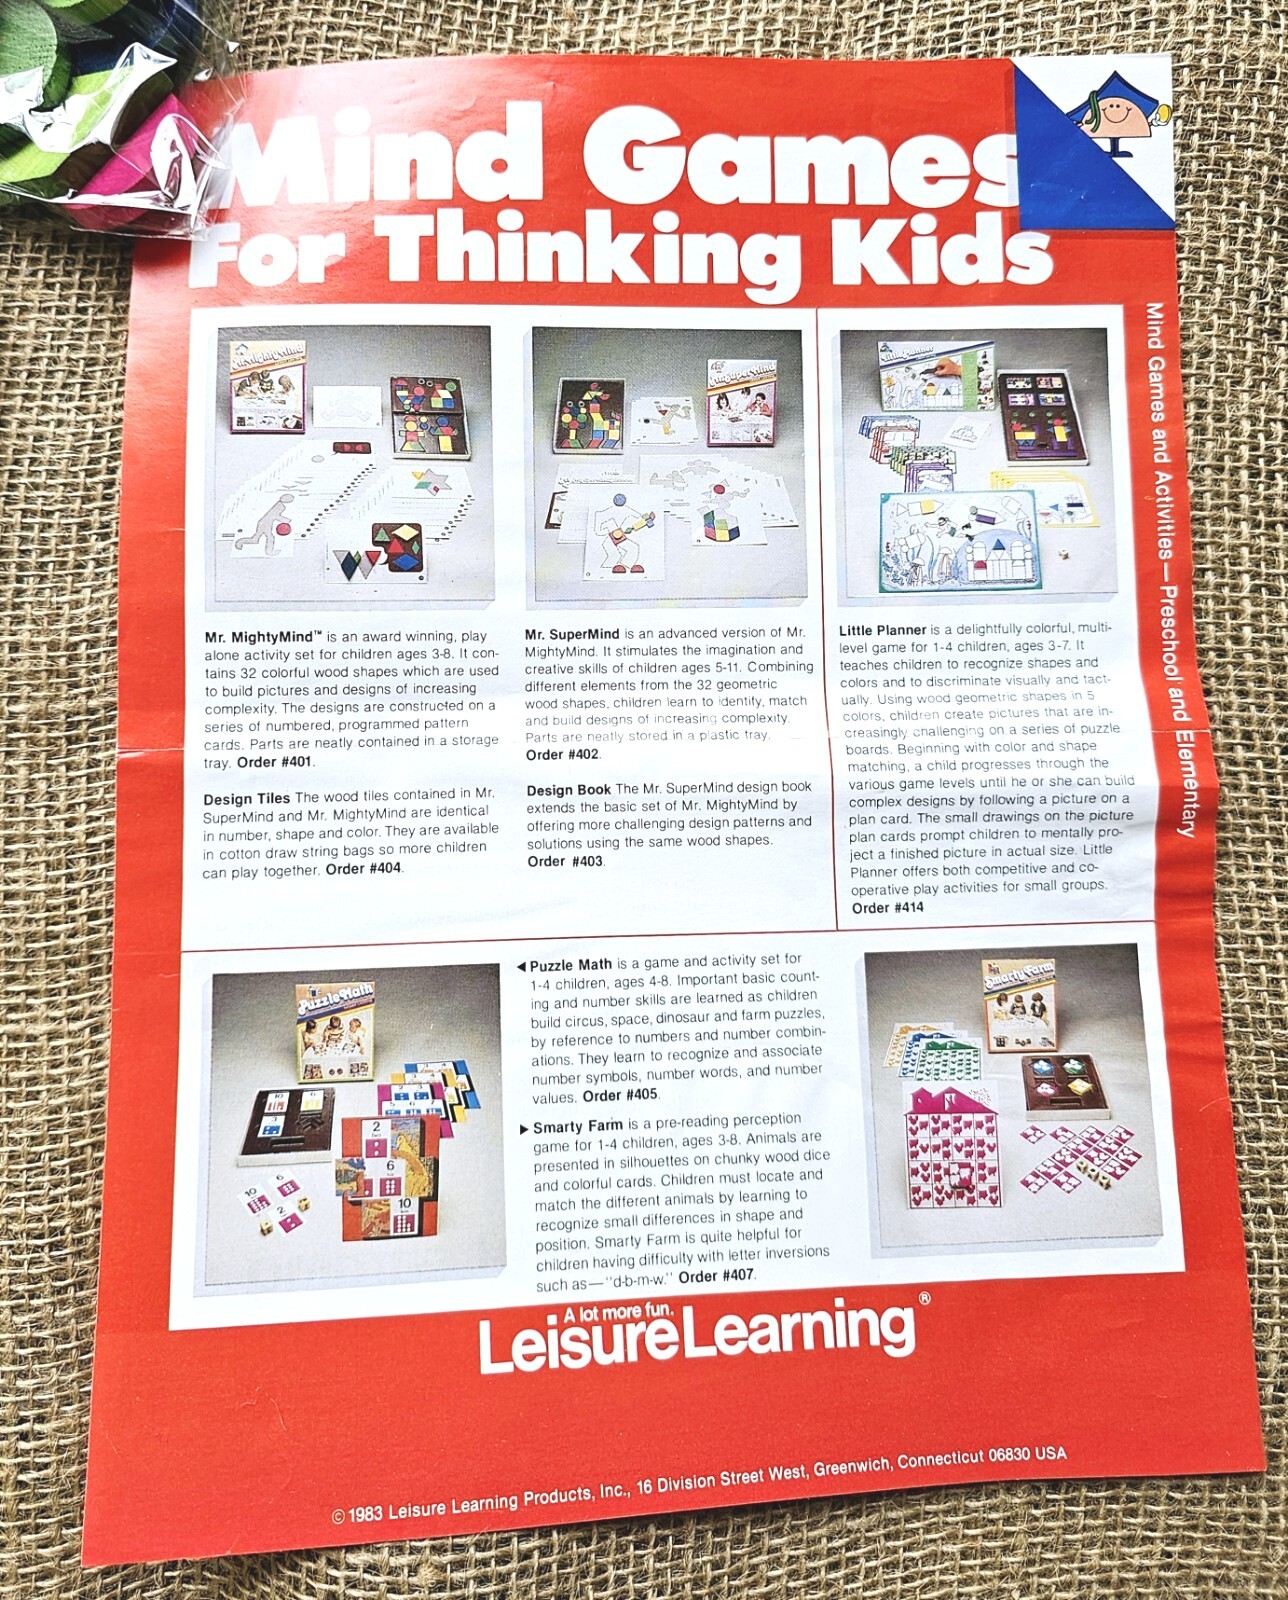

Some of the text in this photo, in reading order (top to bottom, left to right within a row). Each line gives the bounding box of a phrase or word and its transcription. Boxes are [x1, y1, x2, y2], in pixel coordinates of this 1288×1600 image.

[211, 101, 543, 209] Mind
[188, 208, 1053, 305] For Thinking Kids
[1146, 303, 1165, 349] Mind
[1148, 356, 1166, 422] Games
[1152, 429, 1172, 463] and
[205, 631, 226, 644] Mr.
[327, 630, 337, 643] is
[341, 633, 358, 643] an
[362, 630, 401, 643] award
[405, 630, 457, 644] winning,
[461, 630, 487, 644] play
[525, 626, 806, 643] Mr. SuperMind is an advanced version of Mr.
[839, 622, 1112, 637] Little Planner is a delightfully colorful, multi-
[204, 647, 499, 663] alone activity set for children ages 3-8. It con-
[839, 640, 1084, 656] level game for 1-4 children, ages 3-7. It
[1168, 688, 1192, 721] and
[204, 755, 316, 771] tray. Order #401.
[525, 748, 602, 761] Order #402.
[527, 780, 812, 799] Design Book The Mr. SuperMind design book
[1174, 730, 1203, 838] Elementary
[203, 787, 495, 808] Design Tiles The wood tiles contained in Mr.
[202, 861, 404, 881] can play together. Order #404.
[527, 855, 606, 868] Order #403.
[852, 901, 924, 915] Order #414
[530, 952, 802, 973] Puzzle Math is a game and activity set for
[531, 970, 820, 991] 1-4 children, ages 4-8. Important basic count-
[532, 1087, 661, 1105] values. Order #405.
[373, 1121, 380, 1131] 2
[533, 1112, 802, 1136] Smarty Farm is a pre-reading perception
[387, 1160, 395, 1170] 6
[245, 1188, 257, 1197] 10
[535, 1188, 808, 1212] match the different animals by learning to
[398, 1198, 411, 1208] 10
[536, 1278, 568, 1293] such
[678, 1270, 718, 1284] Order
[722, 1267, 757, 1282] #407.
[563, 1302, 674, 1324] A lot more fun.
[389, 1503, 446, 1519] Leisure
[452, 1495, 518, 1514] Learning
[524, 1487, 595, 1506] Products,
[600, 1484, 630, 1498] Inc.,
[637, 1479, 652, 1494] 16
[658, 1475, 715, 1492] Division
[720, 1469, 764, 1486] Street
[768, 1465, 809, 1481] West,
[814, 1457, 893, 1476] Greenwich,
[897, 1450, 984, 1469] Connecticut
[989, 1447, 1030, 1462] 06830
[1035, 1446, 1067, 1460] USA
